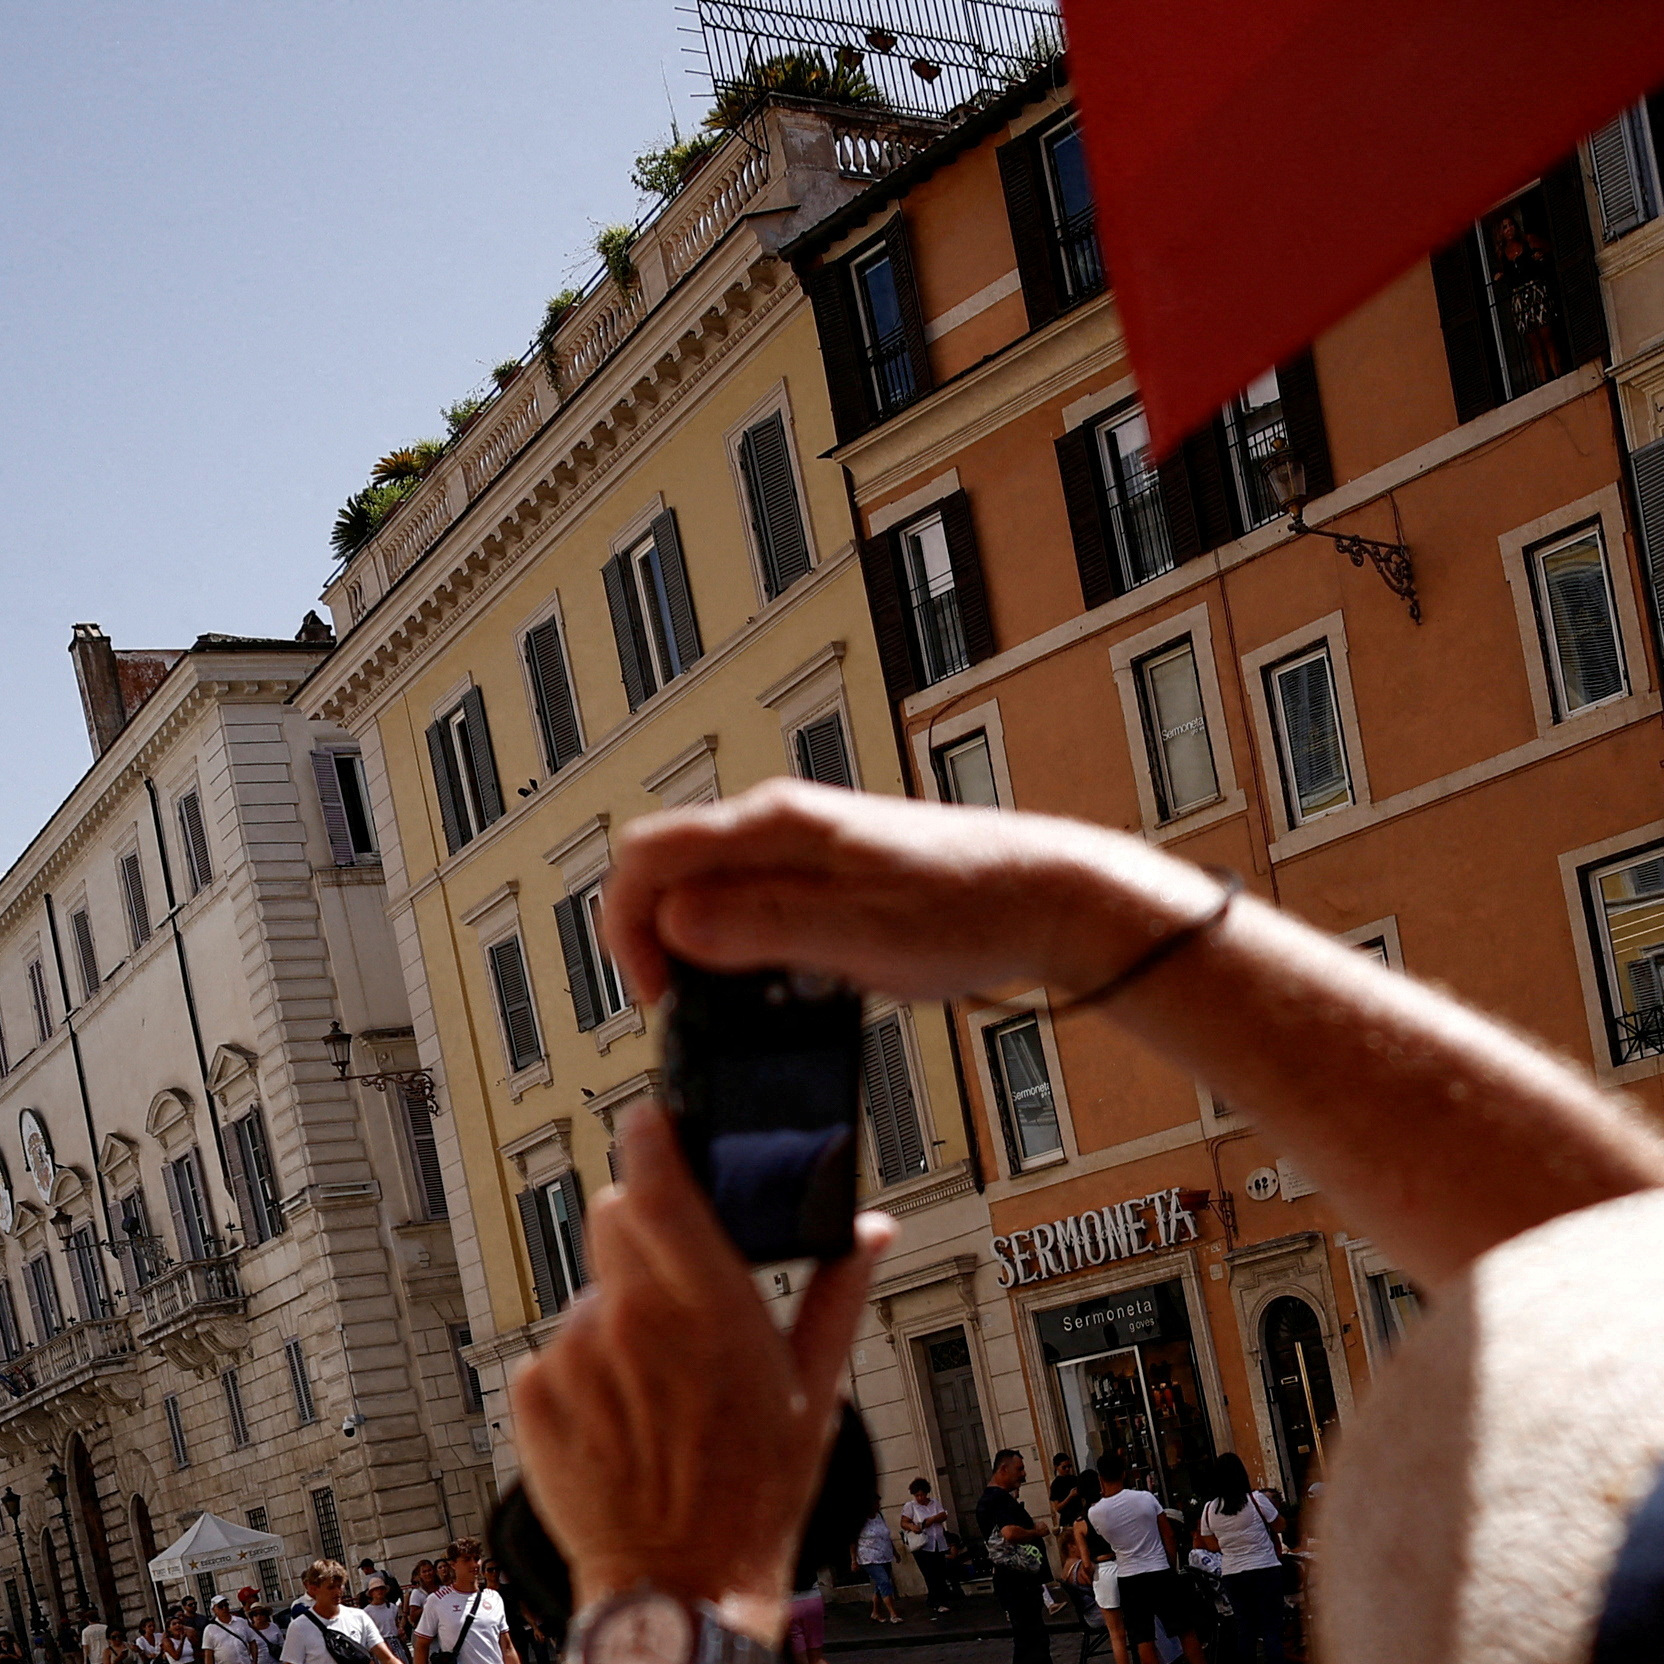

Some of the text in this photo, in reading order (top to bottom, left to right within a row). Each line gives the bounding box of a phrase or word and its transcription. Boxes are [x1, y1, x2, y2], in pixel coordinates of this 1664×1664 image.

[1162, 716, 1204, 741] Sermoneta
[1254, 1176, 1269, 1191] 62
[989, 1186, 1199, 1289] SERMONETA
[1063, 1300, 1153, 1331] Sermoneta
